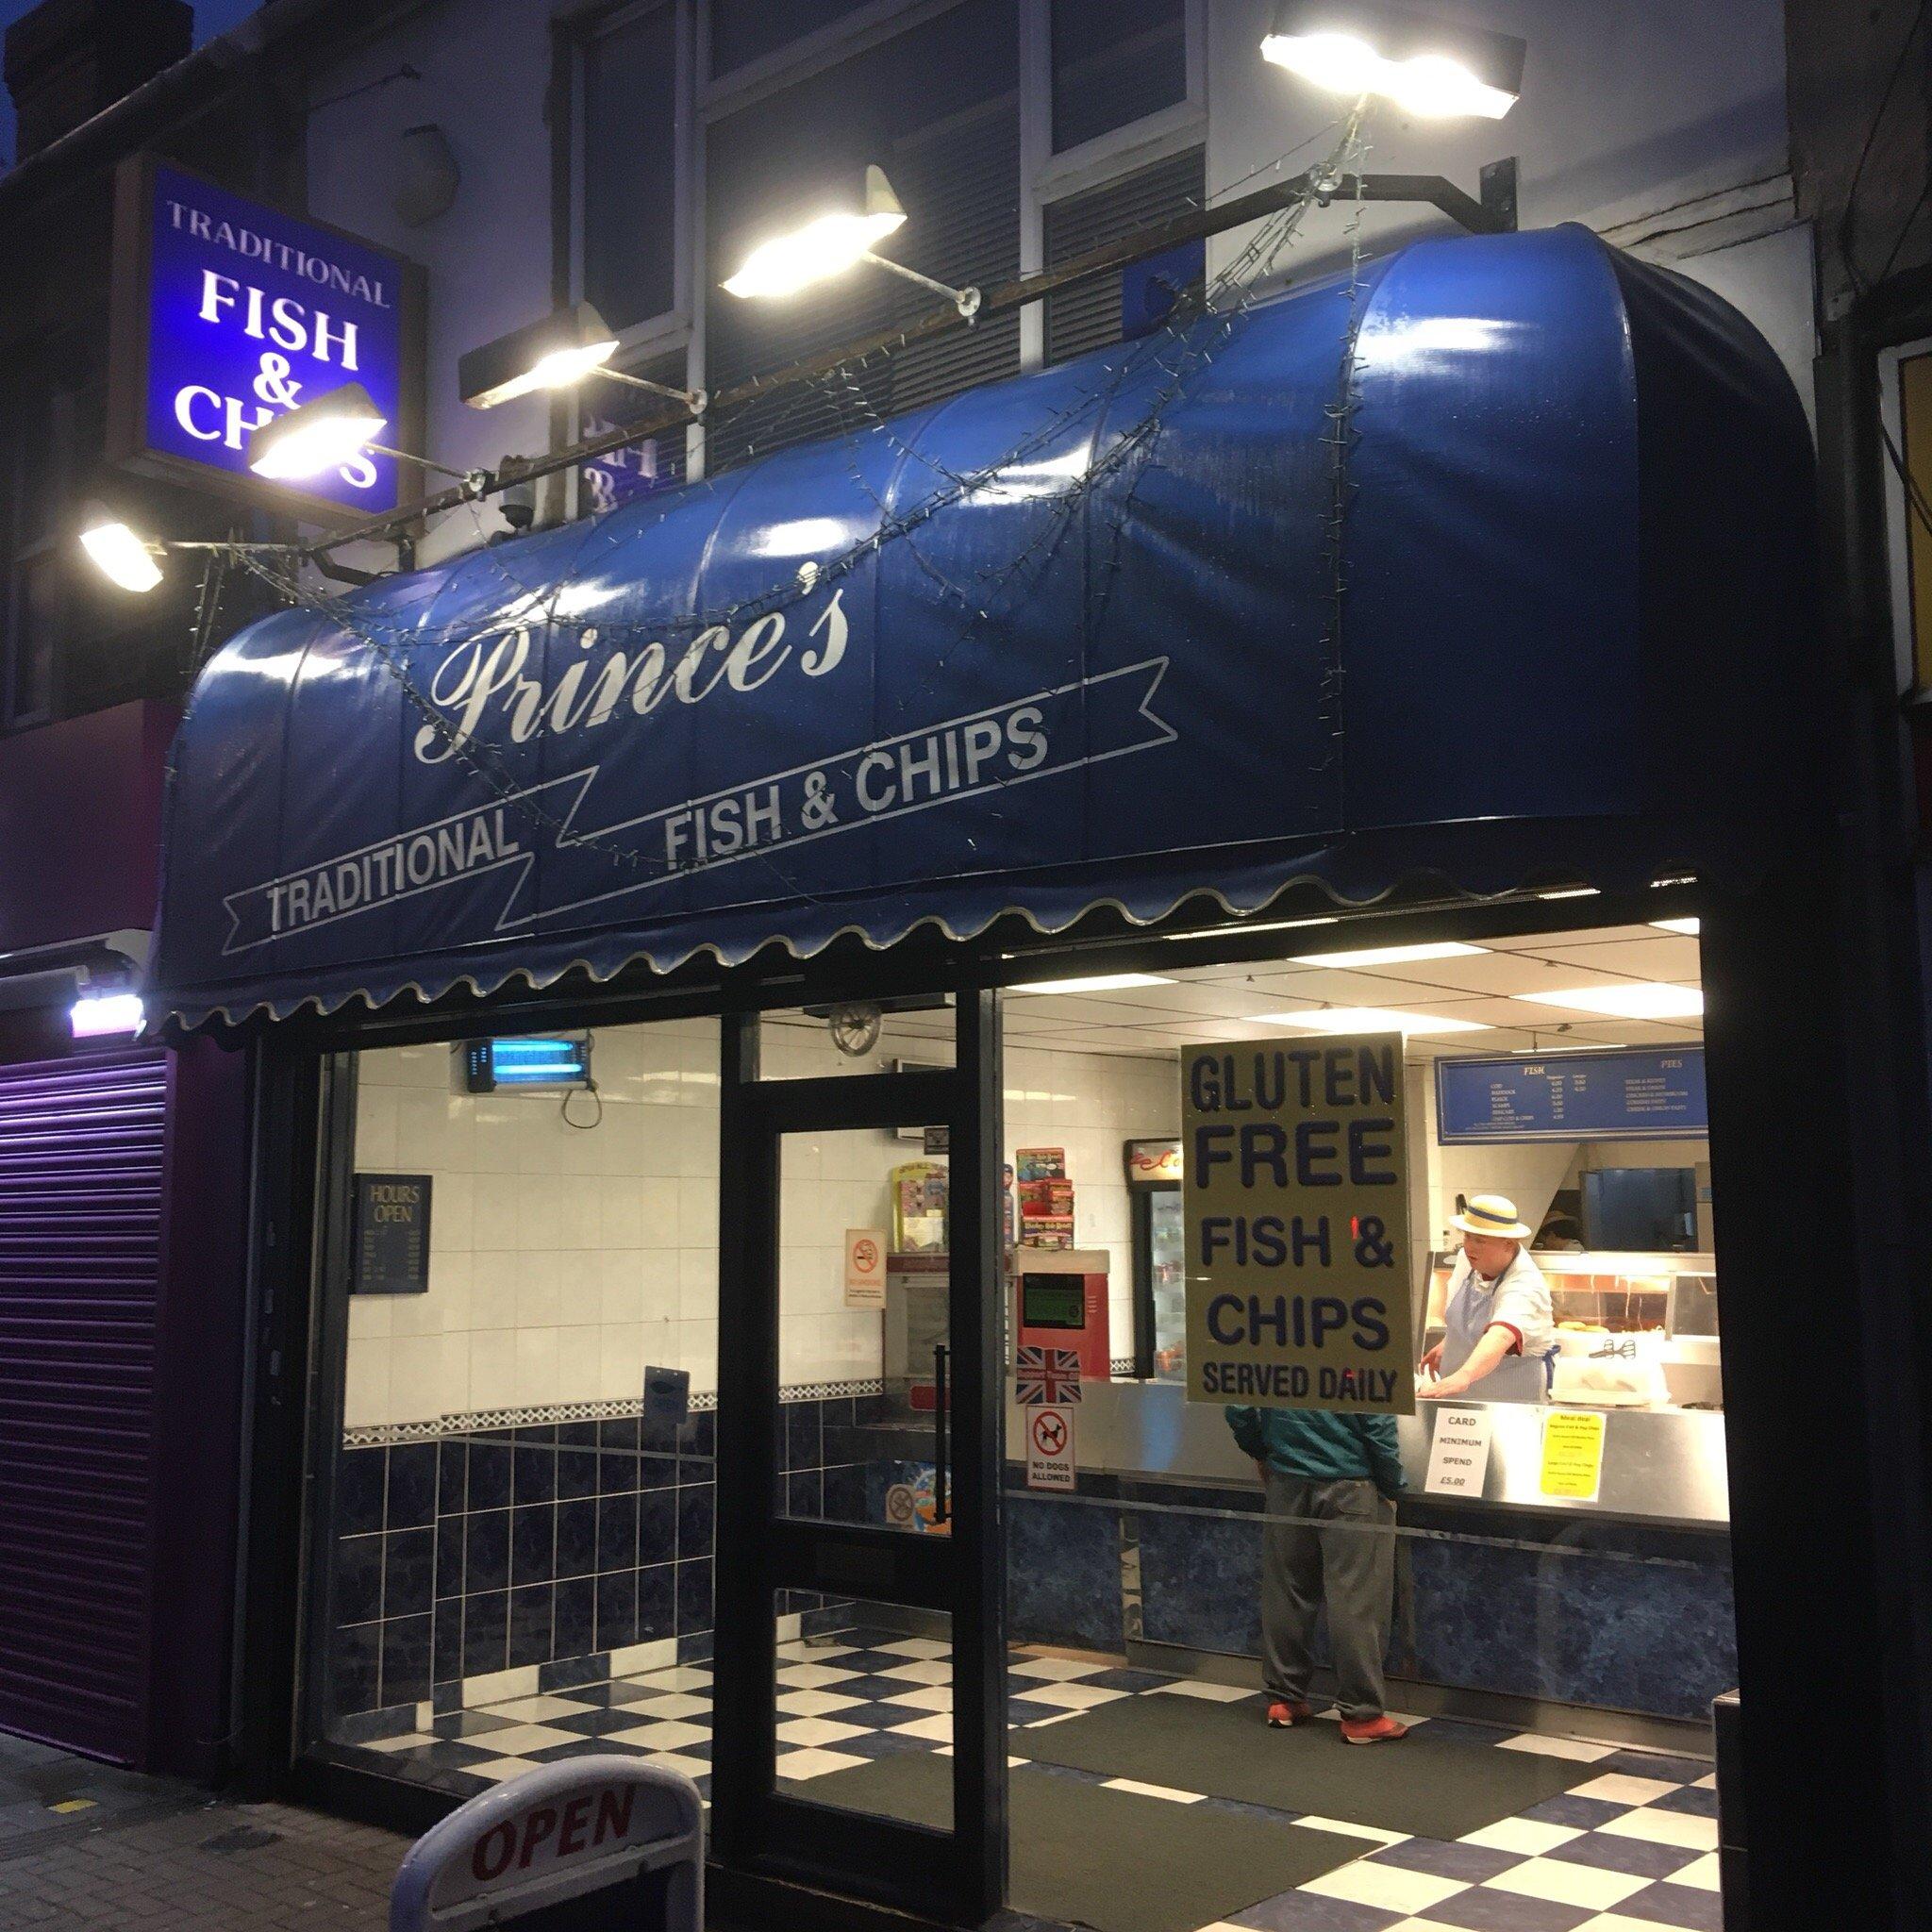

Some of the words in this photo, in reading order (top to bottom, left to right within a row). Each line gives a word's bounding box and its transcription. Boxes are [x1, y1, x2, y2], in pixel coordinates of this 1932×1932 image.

[167, 200, 390, 308] TRADITIONAL
[199, 269, 358, 371] FISH
[253, 352, 303, 409] &
[175, 385, 377, 488] CHS
[414, 561, 848, 763] Prince's
[267, 808, 520, 931] TRADITIONAL
[665, 785, 782, 870] FISH
[801, 771, 839, 829] &
[855, 708, 1048, 812] CHIPS
[1191, 1043, 1396, 1113] GLUTEN
[1524, 1065, 1546, 1075] FISH
[1195, 1118, 1398, 1190] FREE
[370, 1185, 420, 1204] HOURS
[374, 1205, 414, 1223] OPEN
[1201, 1215, 1331, 1268] FISH
[1355, 1214, 1395, 1269] &
[1207, 1293, 1391, 1351] CHIPS
[1203, 1361, 1309, 1399] SERVED
[1318, 1367, 1398, 1403] DAILY
[1440, 1437, 1482, 1447] MINIMUM
[1448, 1416, 1476, 1426] CARD
[1032, 1473, 1071, 1482] ALLOWED
[1046, 1462, 1070, 1472] DOGS
[1440, 1476, 1466, 1487] £5.00
[1442, 1457, 1473, 1466] SPEND
[472, 1783, 637, 1882] OPEN
